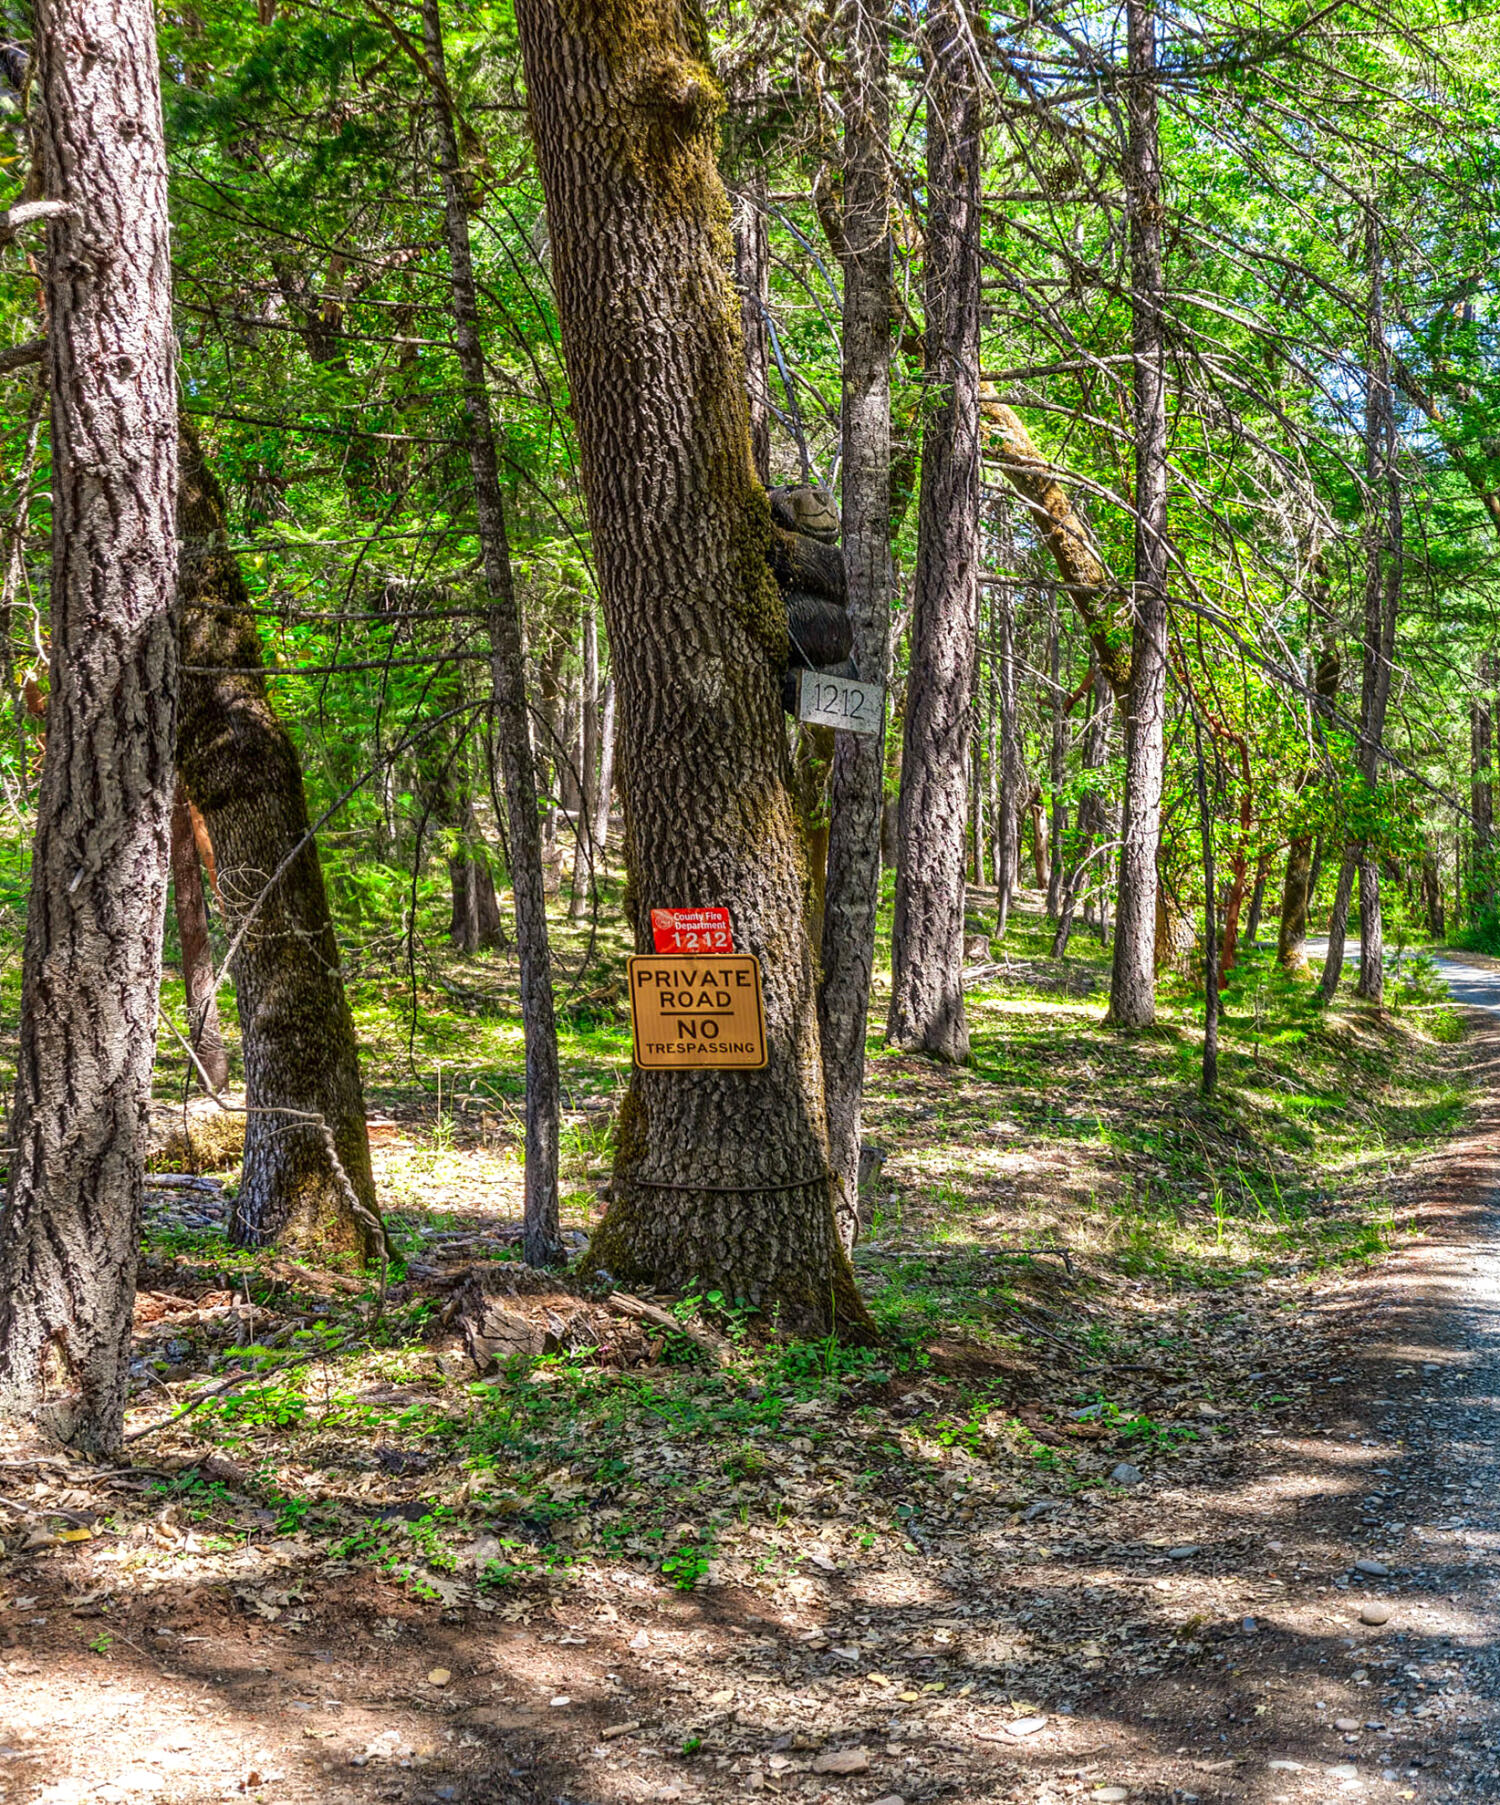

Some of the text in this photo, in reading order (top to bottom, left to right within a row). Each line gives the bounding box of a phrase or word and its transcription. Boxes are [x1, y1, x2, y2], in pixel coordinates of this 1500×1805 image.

[814, 683, 865, 720] 1212
[673, 911, 722, 921] County Fire
[675, 921, 726, 931] Department
[672, 931, 728, 948] 1212
[637, 970, 751, 987] PRIVATE
[660, 991, 731, 1007] ROAD
[677, 1019, 719, 1039] NO
[646, 1043, 754, 1054] TRESPASSING
